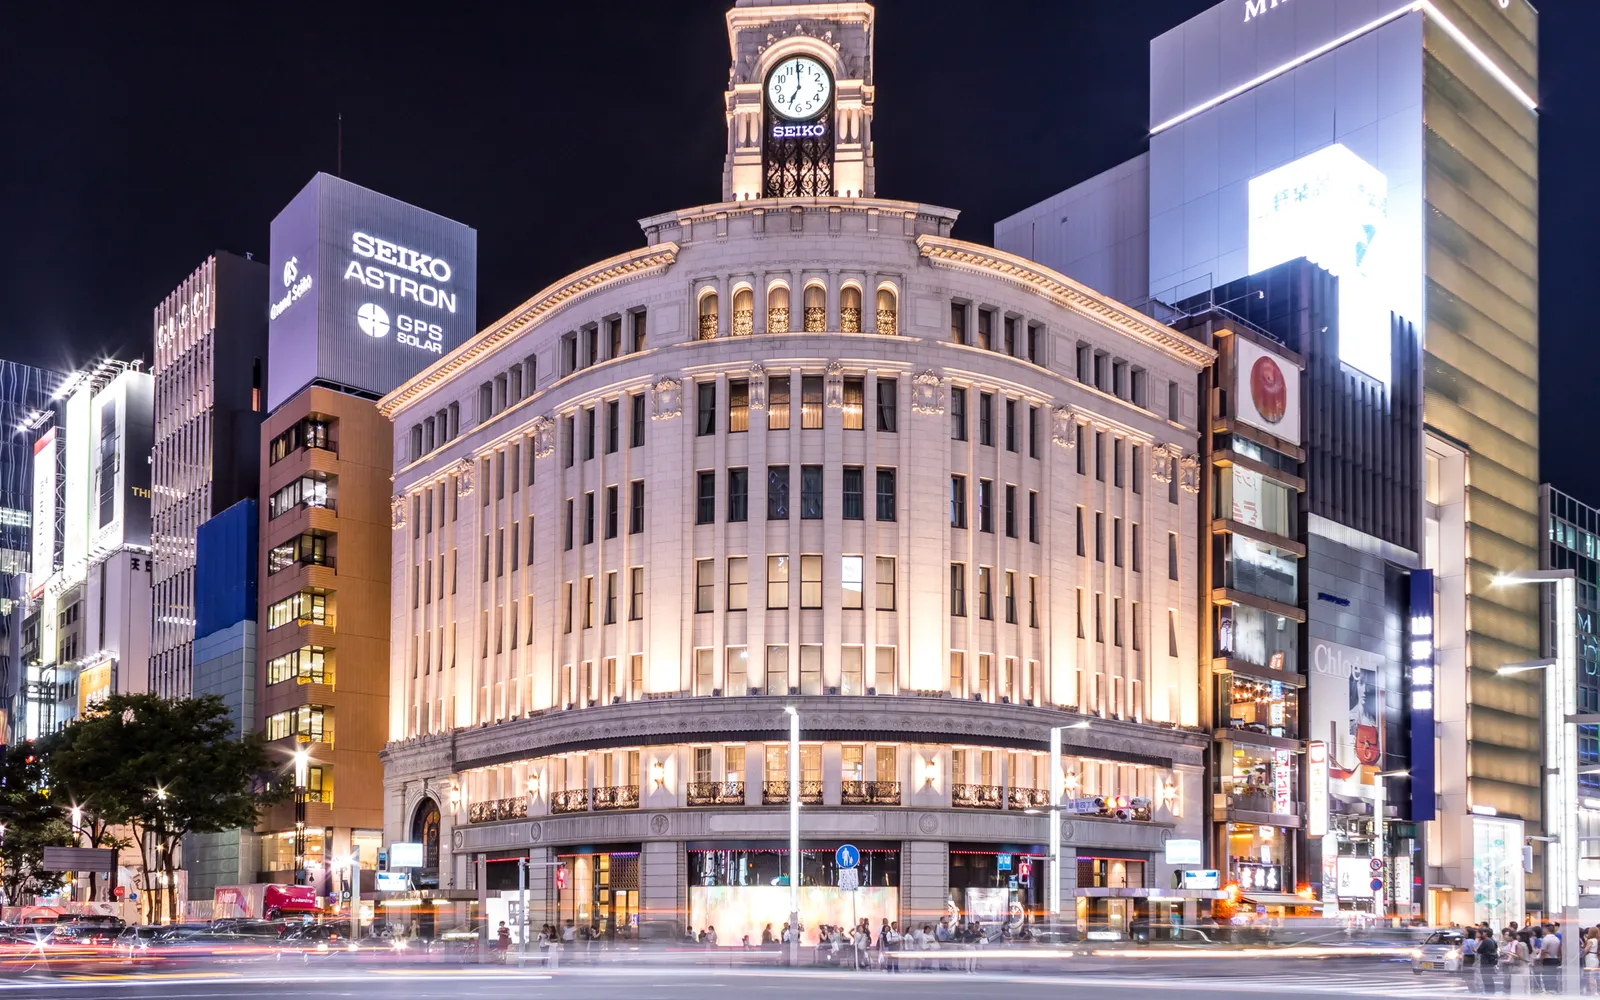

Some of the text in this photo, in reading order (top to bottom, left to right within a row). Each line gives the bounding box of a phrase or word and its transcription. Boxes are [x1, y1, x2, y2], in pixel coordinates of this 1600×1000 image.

[786, 67, 793, 75] 11
[808, 67, 811, 75] 1
[778, 75, 786, 83] 10
[814, 73, 820, 82] 2
[774, 84, 782, 93] 9
[817, 83, 824, 92] 3
[778, 94, 785, 103] 8
[813, 93, 820, 102] 4
[795, 103, 802, 112] 6
[805, 101, 812, 109] 5
[773, 125, 824, 137] SEIKO
[352, 231, 451, 282] SEIKO
[344, 260, 456, 313] ASTRON
[270, 274, 313, 320] Grand Seiko
[397, 314, 443, 341] GPS
[397, 332, 442, 354] SOLAR
[1314, 643, 1361, 681] Chloé
